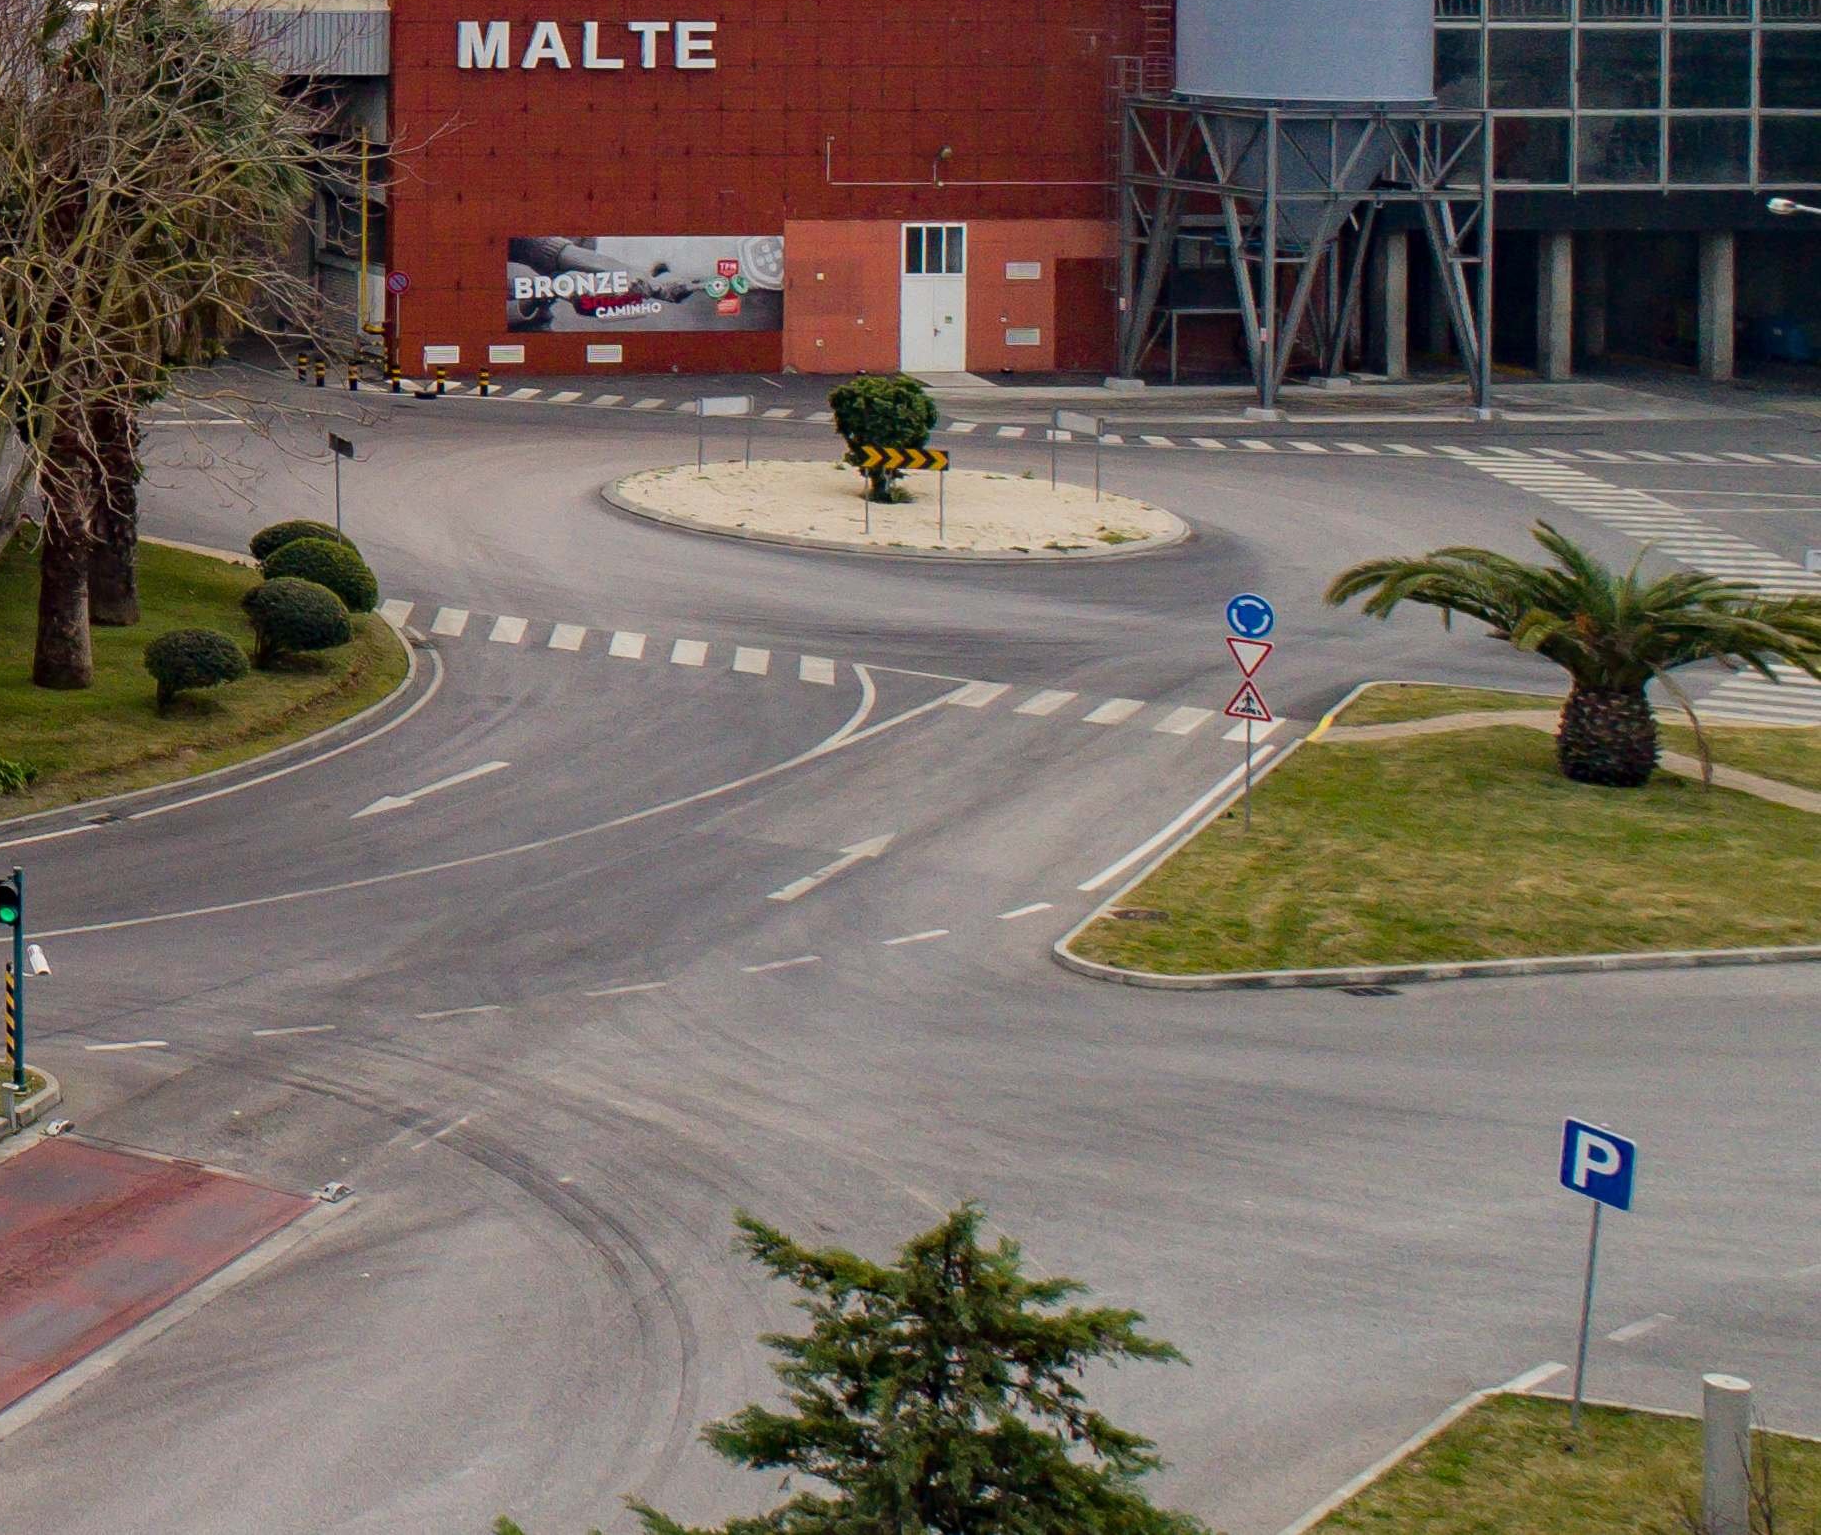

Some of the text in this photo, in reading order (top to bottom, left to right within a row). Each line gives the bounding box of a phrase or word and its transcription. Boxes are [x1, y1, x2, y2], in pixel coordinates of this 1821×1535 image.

[457, 19, 719, 71] MALTE
[514, 270, 630, 300] BRONZE
[595, 302, 663, 319] CAMINHO
[1572, 1129, 1622, 1188] P
